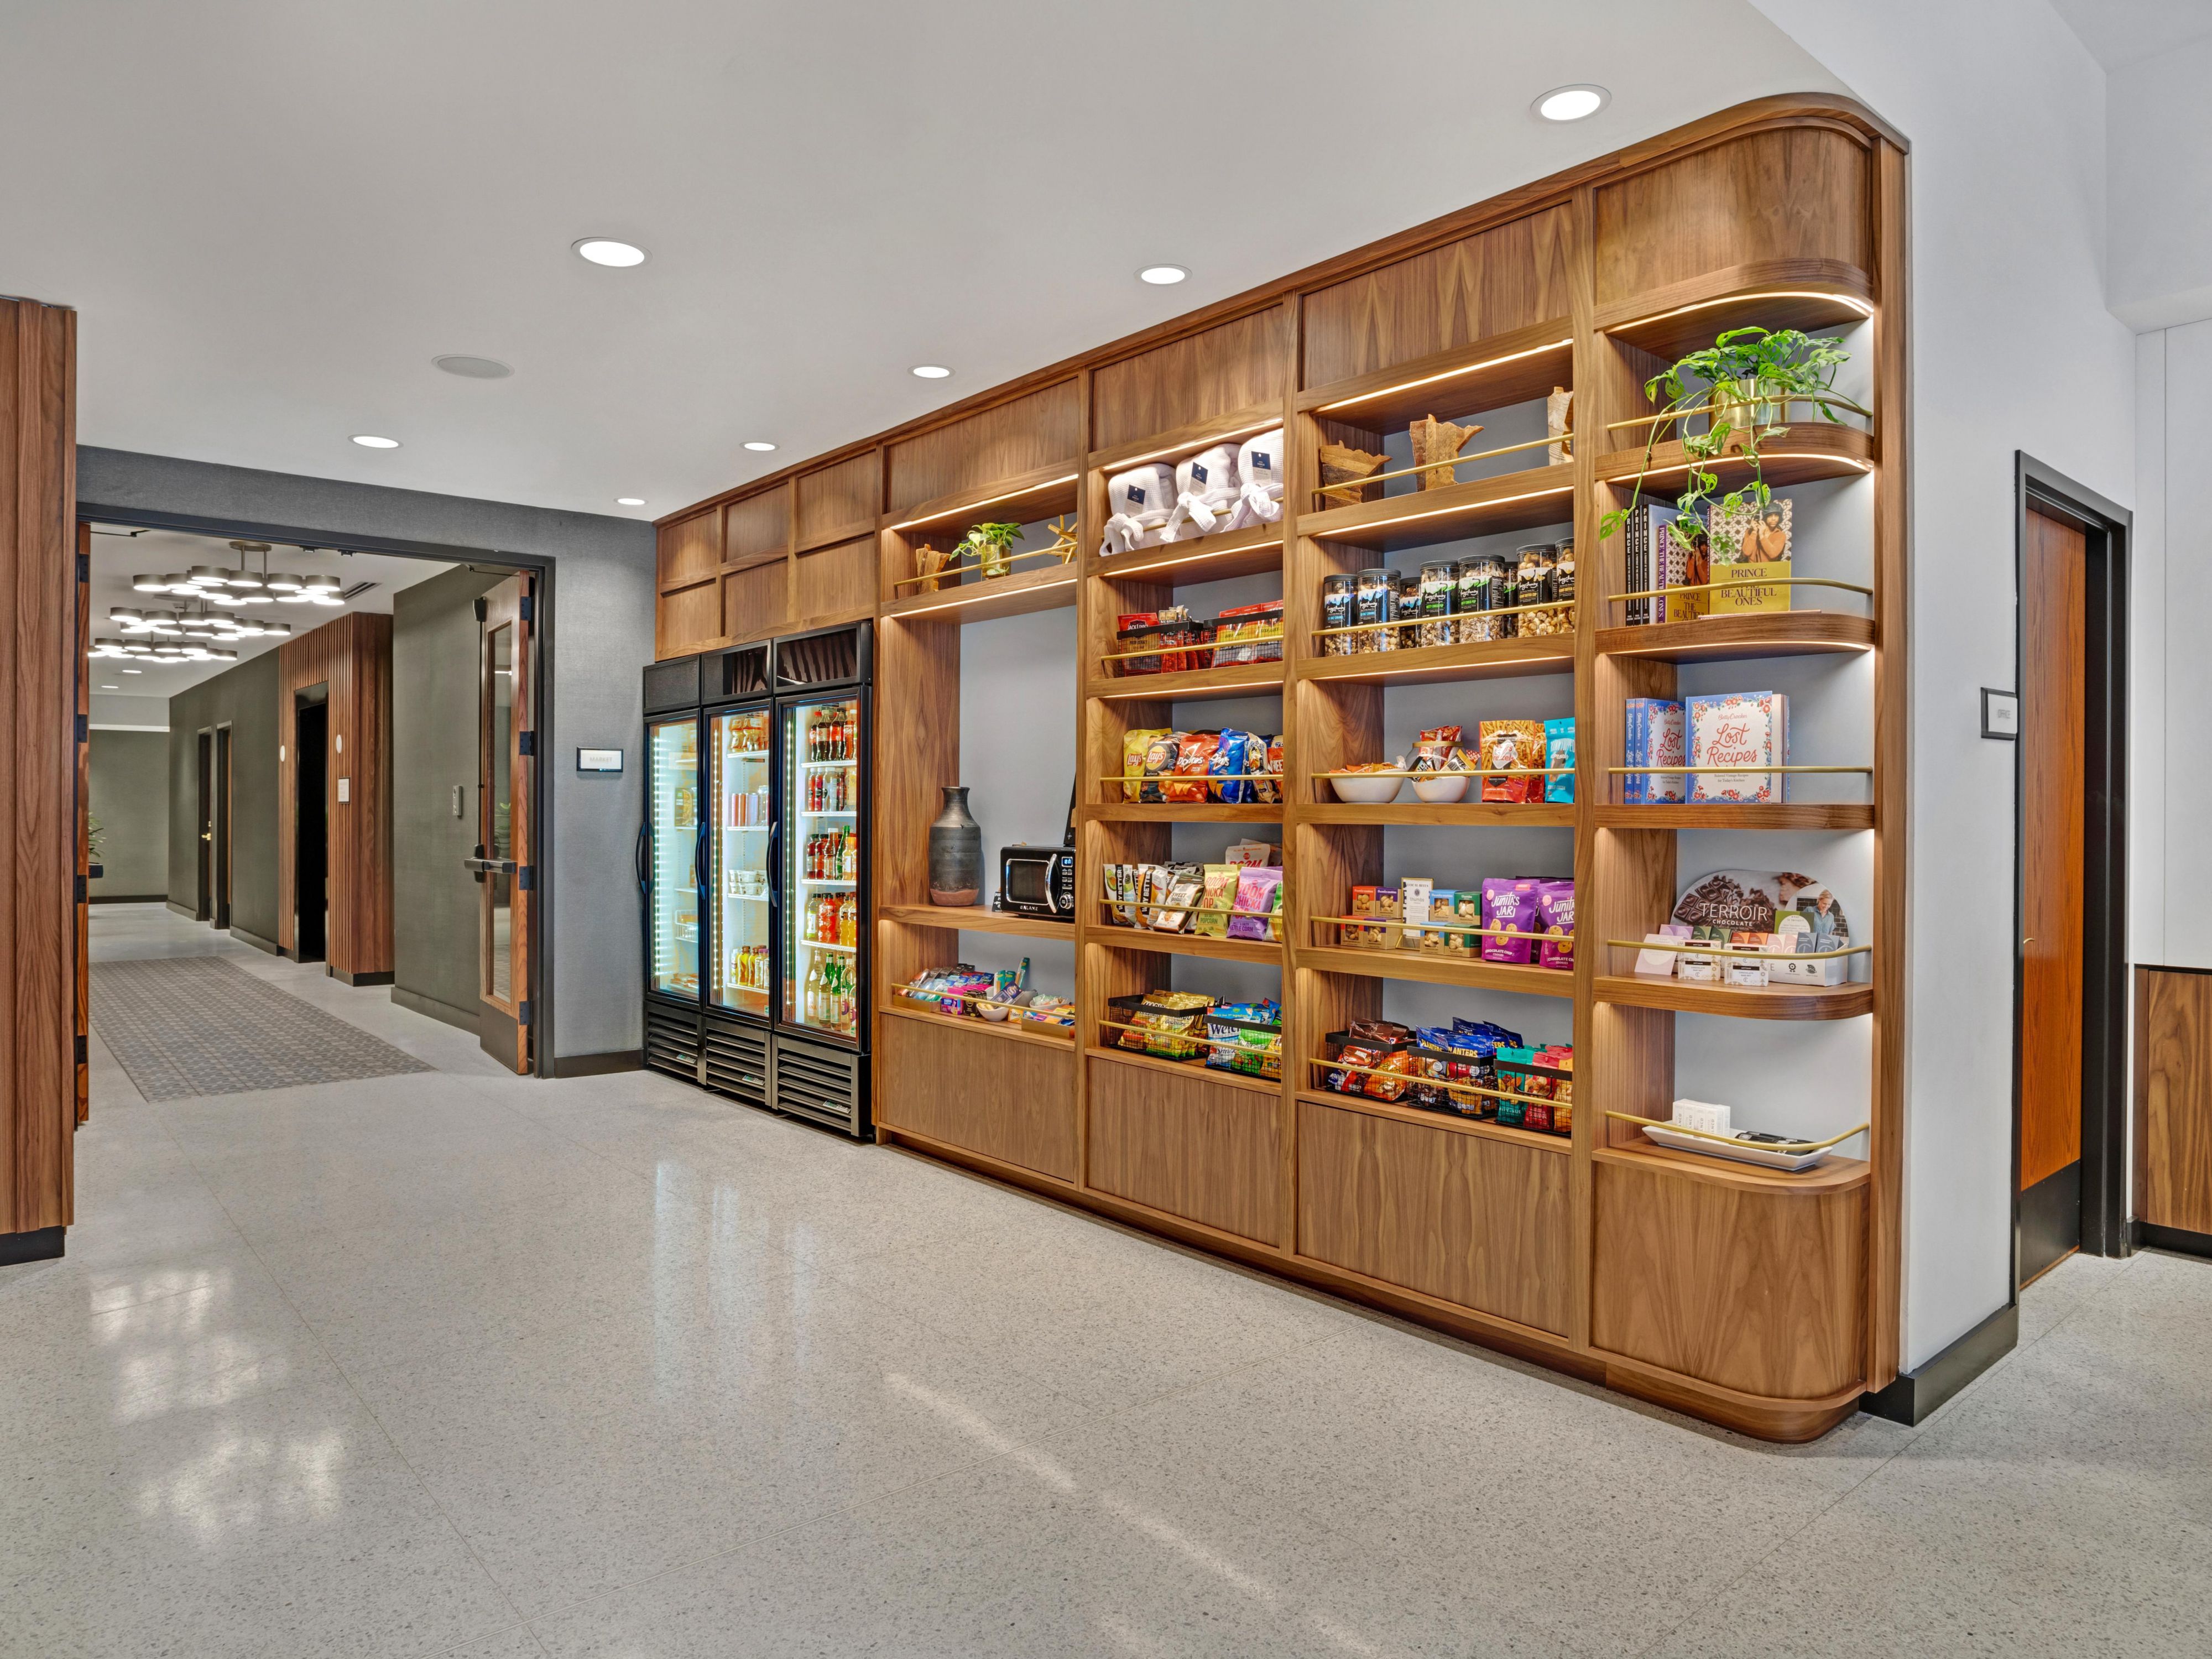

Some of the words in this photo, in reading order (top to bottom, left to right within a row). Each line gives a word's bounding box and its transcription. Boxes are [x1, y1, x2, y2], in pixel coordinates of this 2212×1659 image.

[1731, 568, 1767, 578] PRINCE
[1680, 593, 1700, 602] PRINCE
[1721, 587, 1777, 598] BEAUTIFUL
[1684, 602, 1695, 611] THE
[1735, 597, 1762, 606] ONES
[1674, 609, 1704, 618] BEAUTIF
[1660, 728, 1682, 752] Lost
[1712, 723, 1750, 748] Lost
[1177, 756, 1204, 765] Doritos
[1656, 749, 1686, 767] Recipes
[1707, 746, 1757, 767] Recipes
[1206, 877, 1230, 889] BOOM
[1204, 887, 1224, 898] HICKA
[1238, 883, 1266, 900] BOOM
[1234, 894, 1261, 910] CHICKA
[1496, 906, 1516, 917] JAR
[1699, 902, 1768, 921] TERROIR
